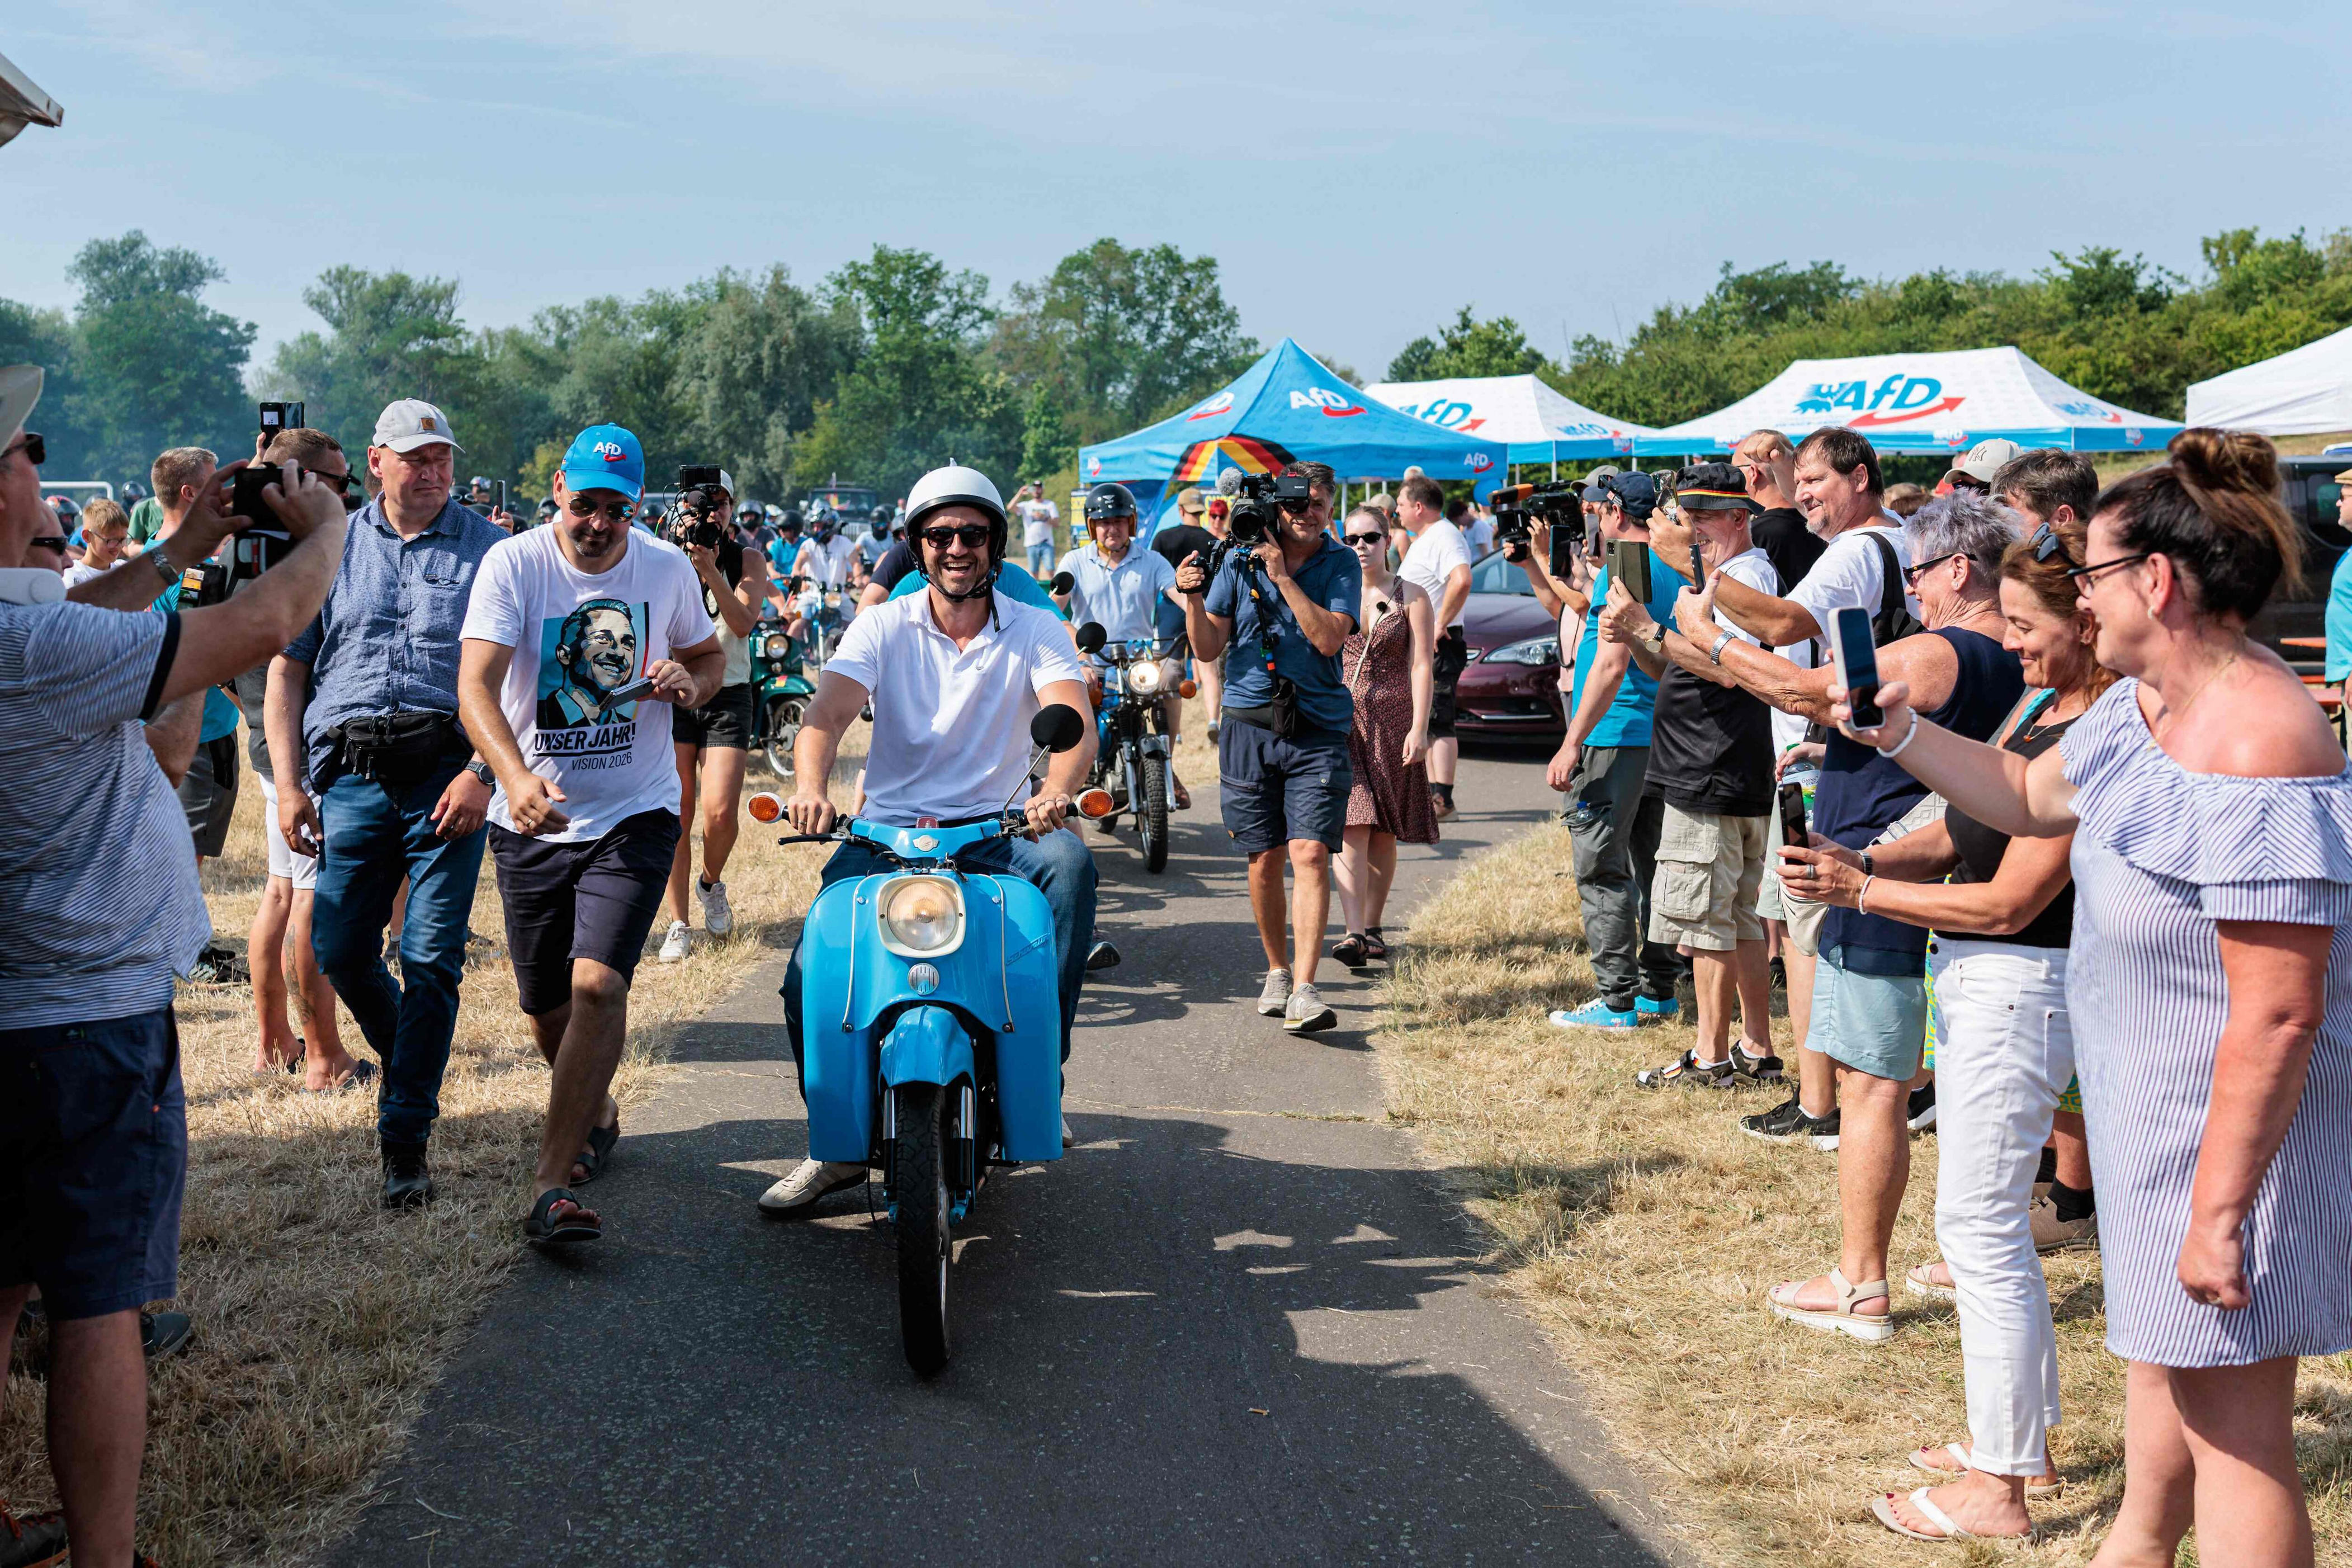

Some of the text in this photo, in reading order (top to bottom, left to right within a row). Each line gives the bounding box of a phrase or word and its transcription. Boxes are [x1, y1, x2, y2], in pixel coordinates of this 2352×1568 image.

[1290, 387, 1348, 409] AfD
[1834, 374, 1942, 411] AfD
[593, 441, 622, 455] AfD
[1464, 452, 1488, 466] AfD
[535, 722, 636, 752] UNSER JAHR!
[572, 752, 632, 771] VISION 2026
